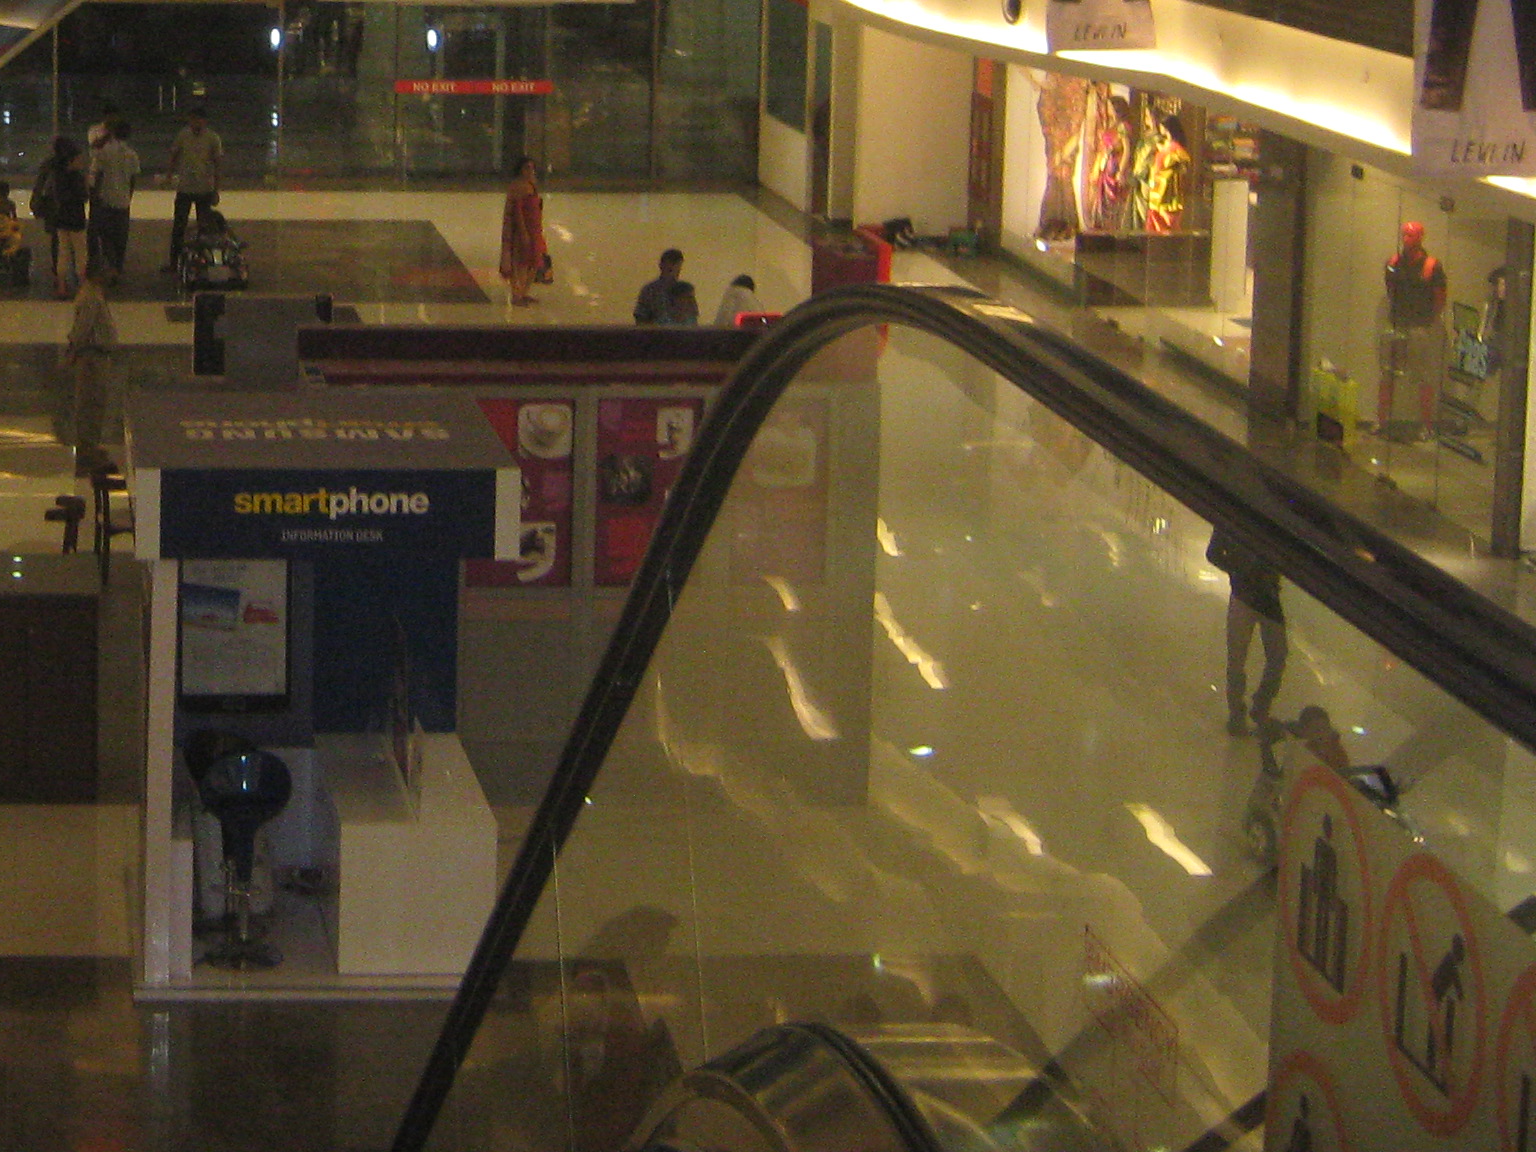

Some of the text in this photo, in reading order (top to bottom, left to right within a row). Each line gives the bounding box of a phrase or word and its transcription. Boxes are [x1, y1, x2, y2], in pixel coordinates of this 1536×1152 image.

[413, 82, 457, 92] NO EXIT
[491, 82, 536, 92] NO EXIT
[233, 485, 431, 521] smartphone
[281, 529, 353, 542] INFORMATION
